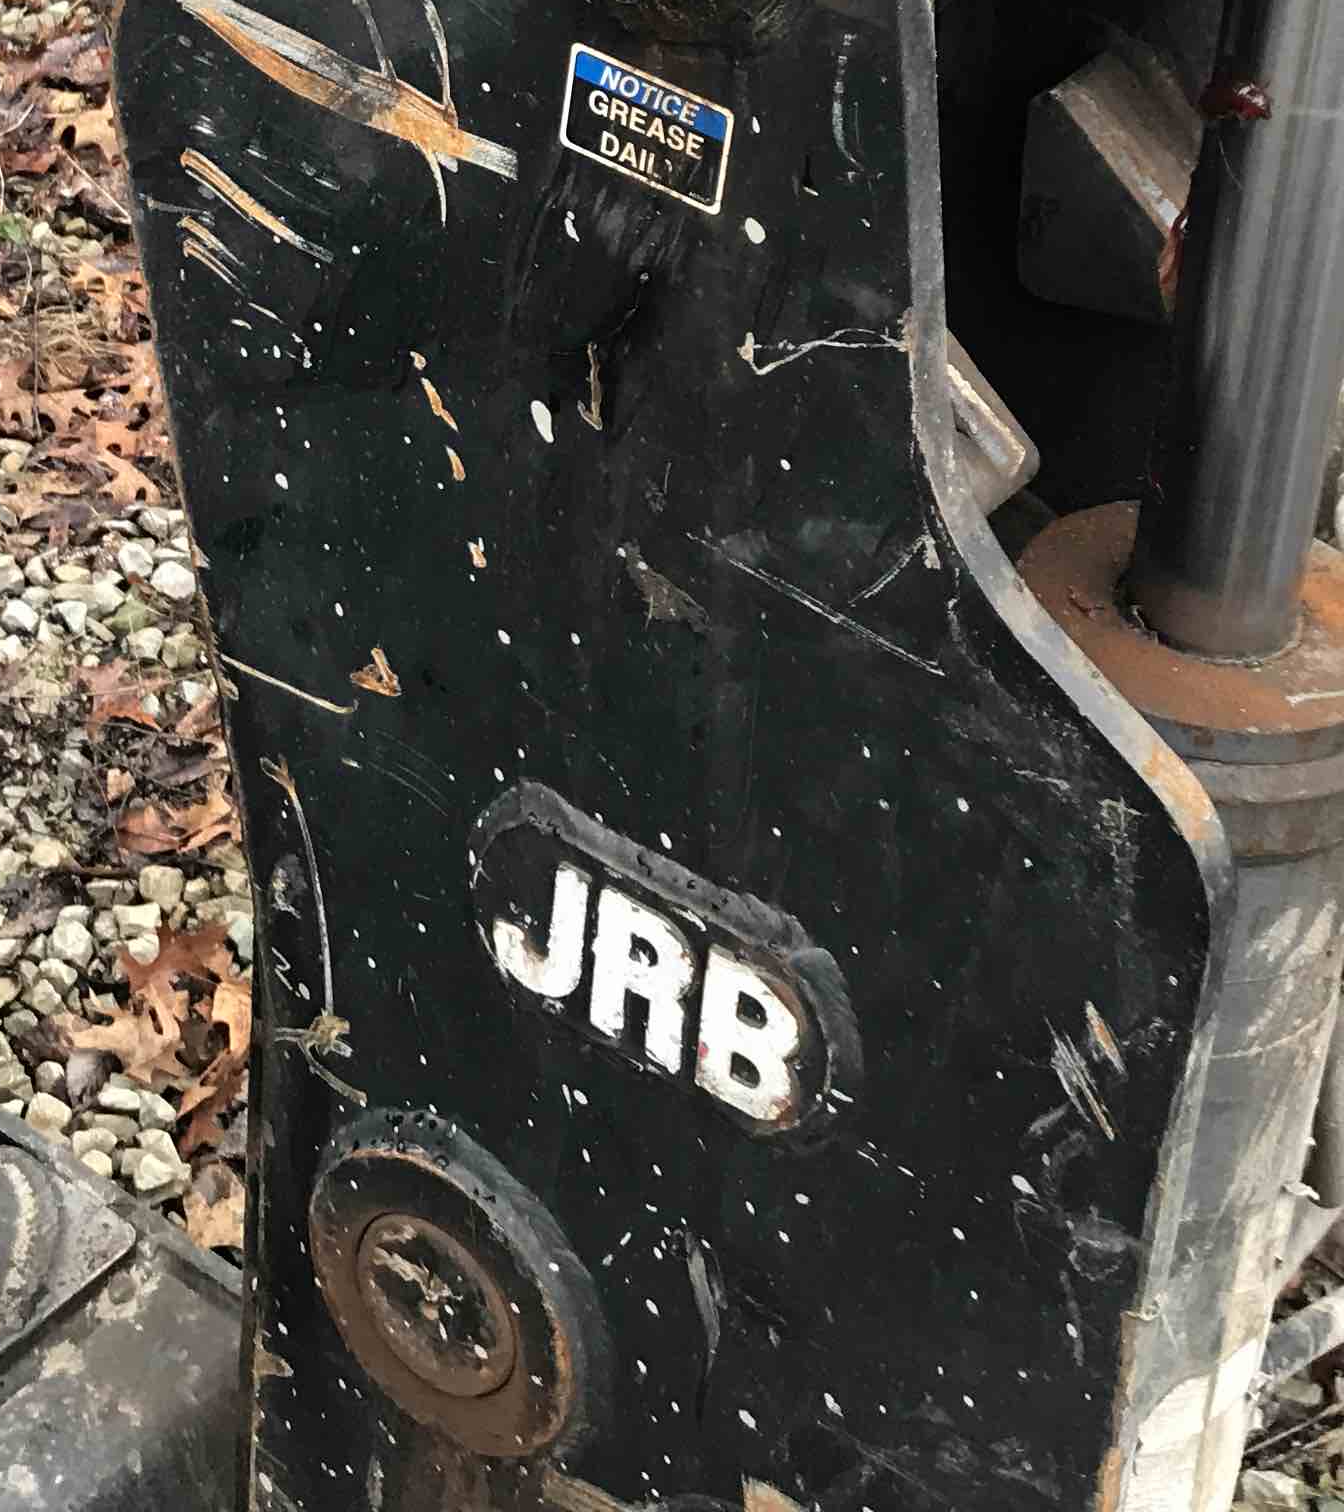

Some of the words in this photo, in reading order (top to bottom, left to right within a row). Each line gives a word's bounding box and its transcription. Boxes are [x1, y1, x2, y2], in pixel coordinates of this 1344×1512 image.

[588, 90, 705, 160] GREASE
[599, 65, 701, 126] NOTICE
[492, 861, 800, 1122] JRB
